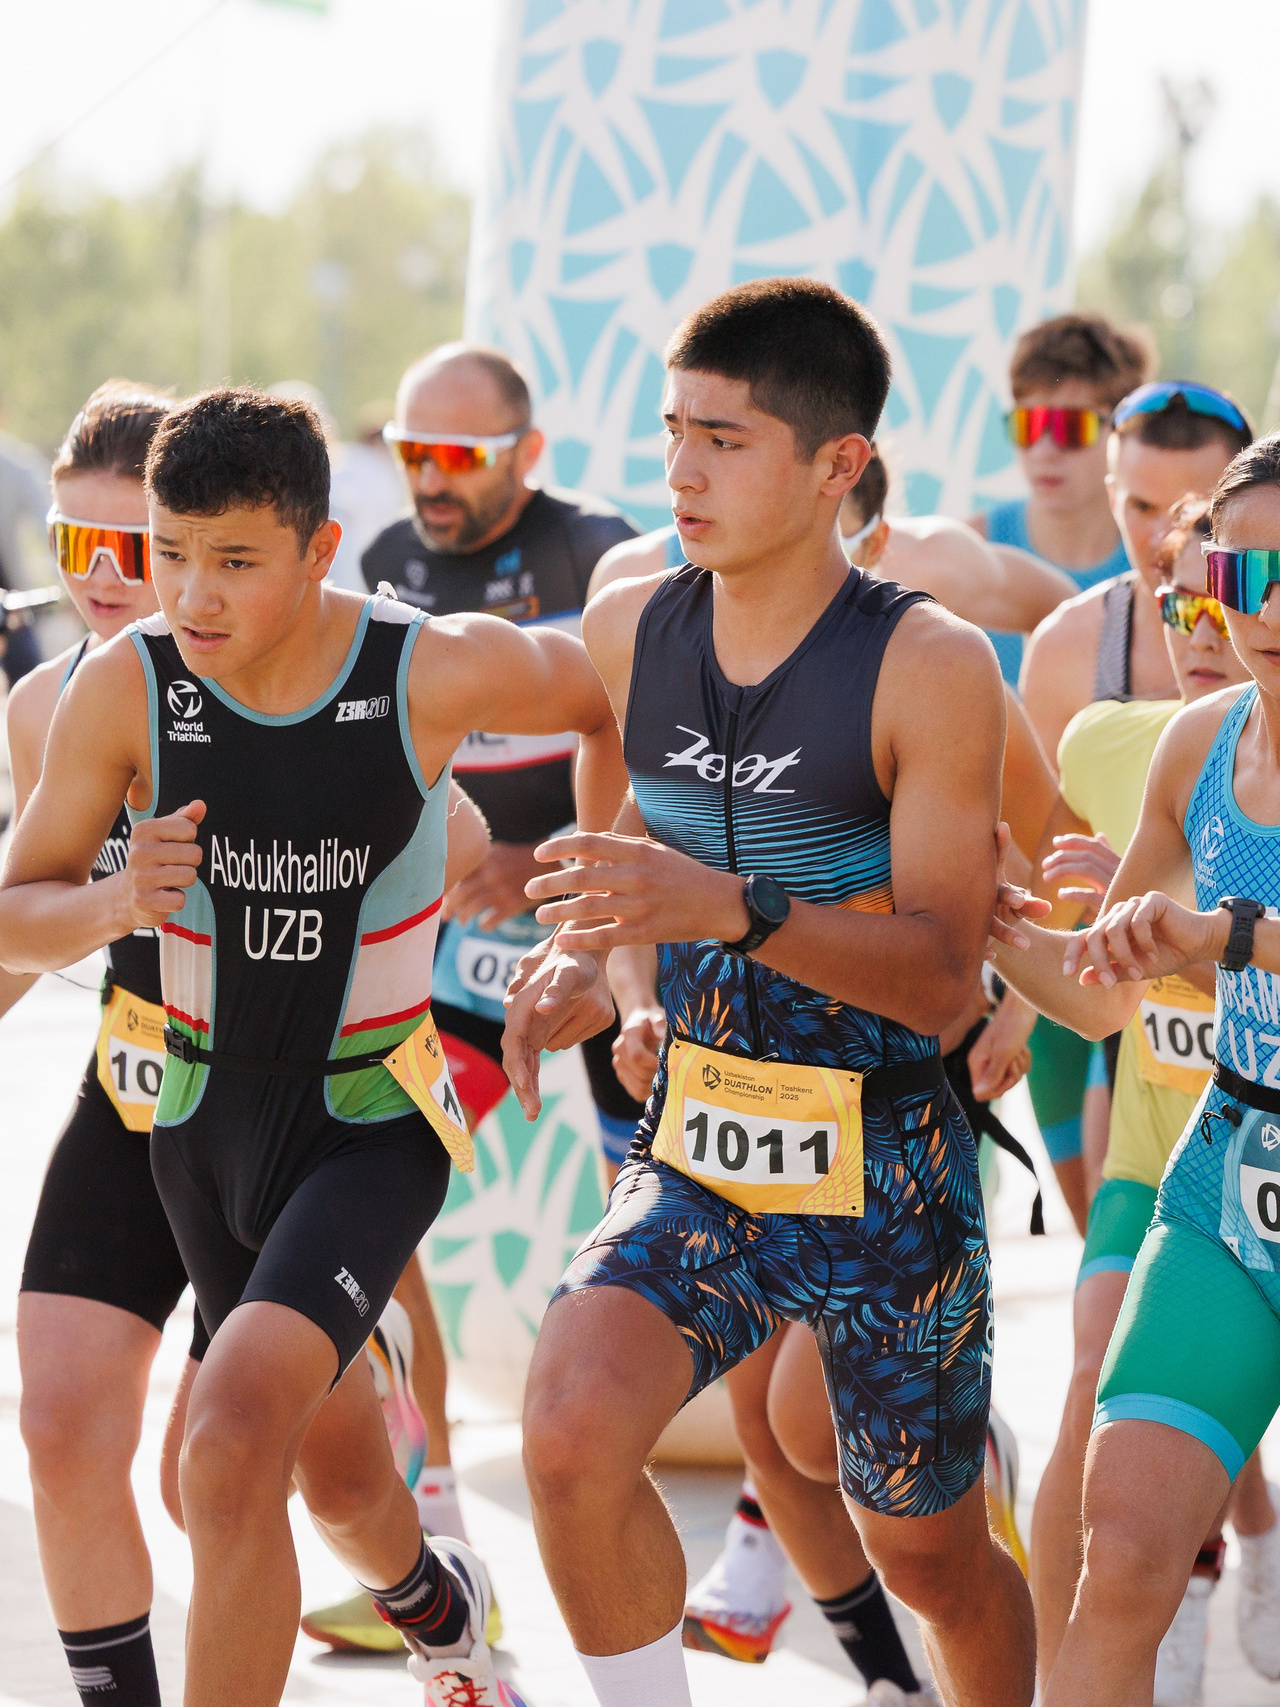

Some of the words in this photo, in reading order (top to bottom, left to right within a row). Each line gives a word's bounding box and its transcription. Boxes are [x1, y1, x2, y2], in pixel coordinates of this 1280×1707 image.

[173, 720, 203, 732] World
[167, 731, 211, 743] Triathlon
[210, 834, 371, 893] Abdukhalilov
[244, 905, 323, 961] UZB
[724, 1070, 755, 1082] Uzbekistan
[724, 1078, 773, 1095] DUATHLON
[780, 1084, 813, 1095] Tashkent
[724, 1086, 765, 1101] Championship
[780, 1092, 799, 1101] 2025
[685, 1111, 829, 1175] 1011
